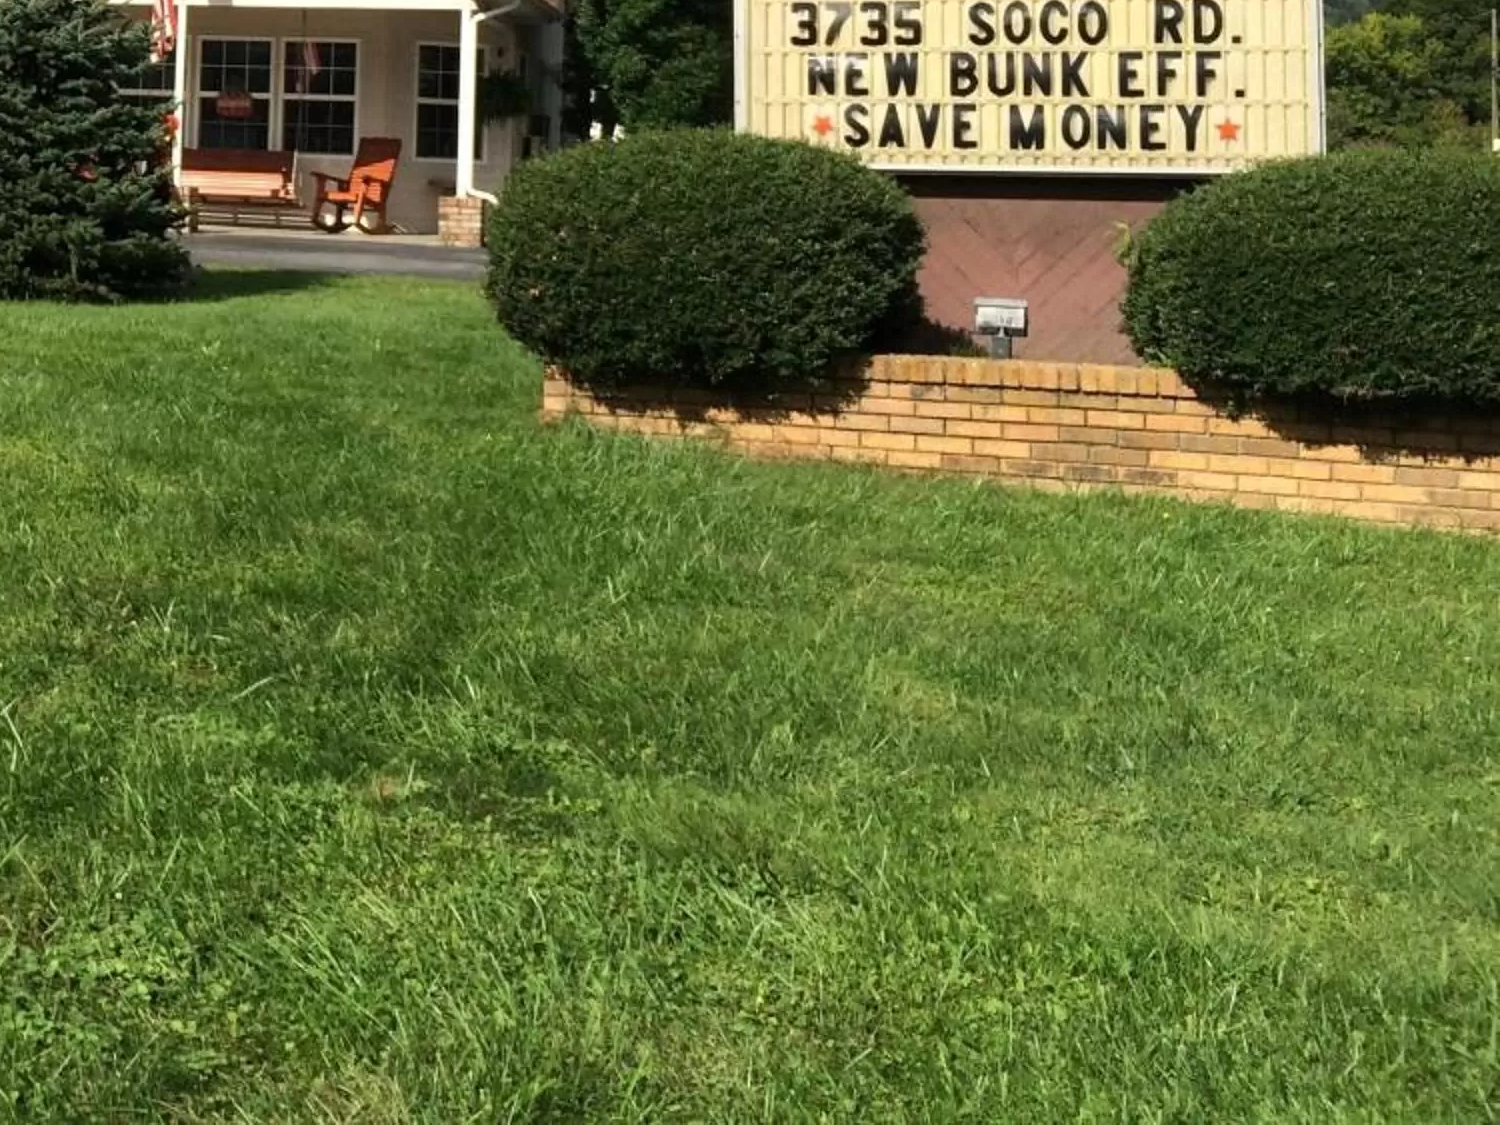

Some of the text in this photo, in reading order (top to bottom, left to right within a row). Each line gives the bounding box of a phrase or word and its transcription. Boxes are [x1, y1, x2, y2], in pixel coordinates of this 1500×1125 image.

[789, 0, 923, 47] 3735
[807, 51, 1247, 97] NEW BUNK EFF.
[843, 102, 1204, 151] SAVE MONEY
